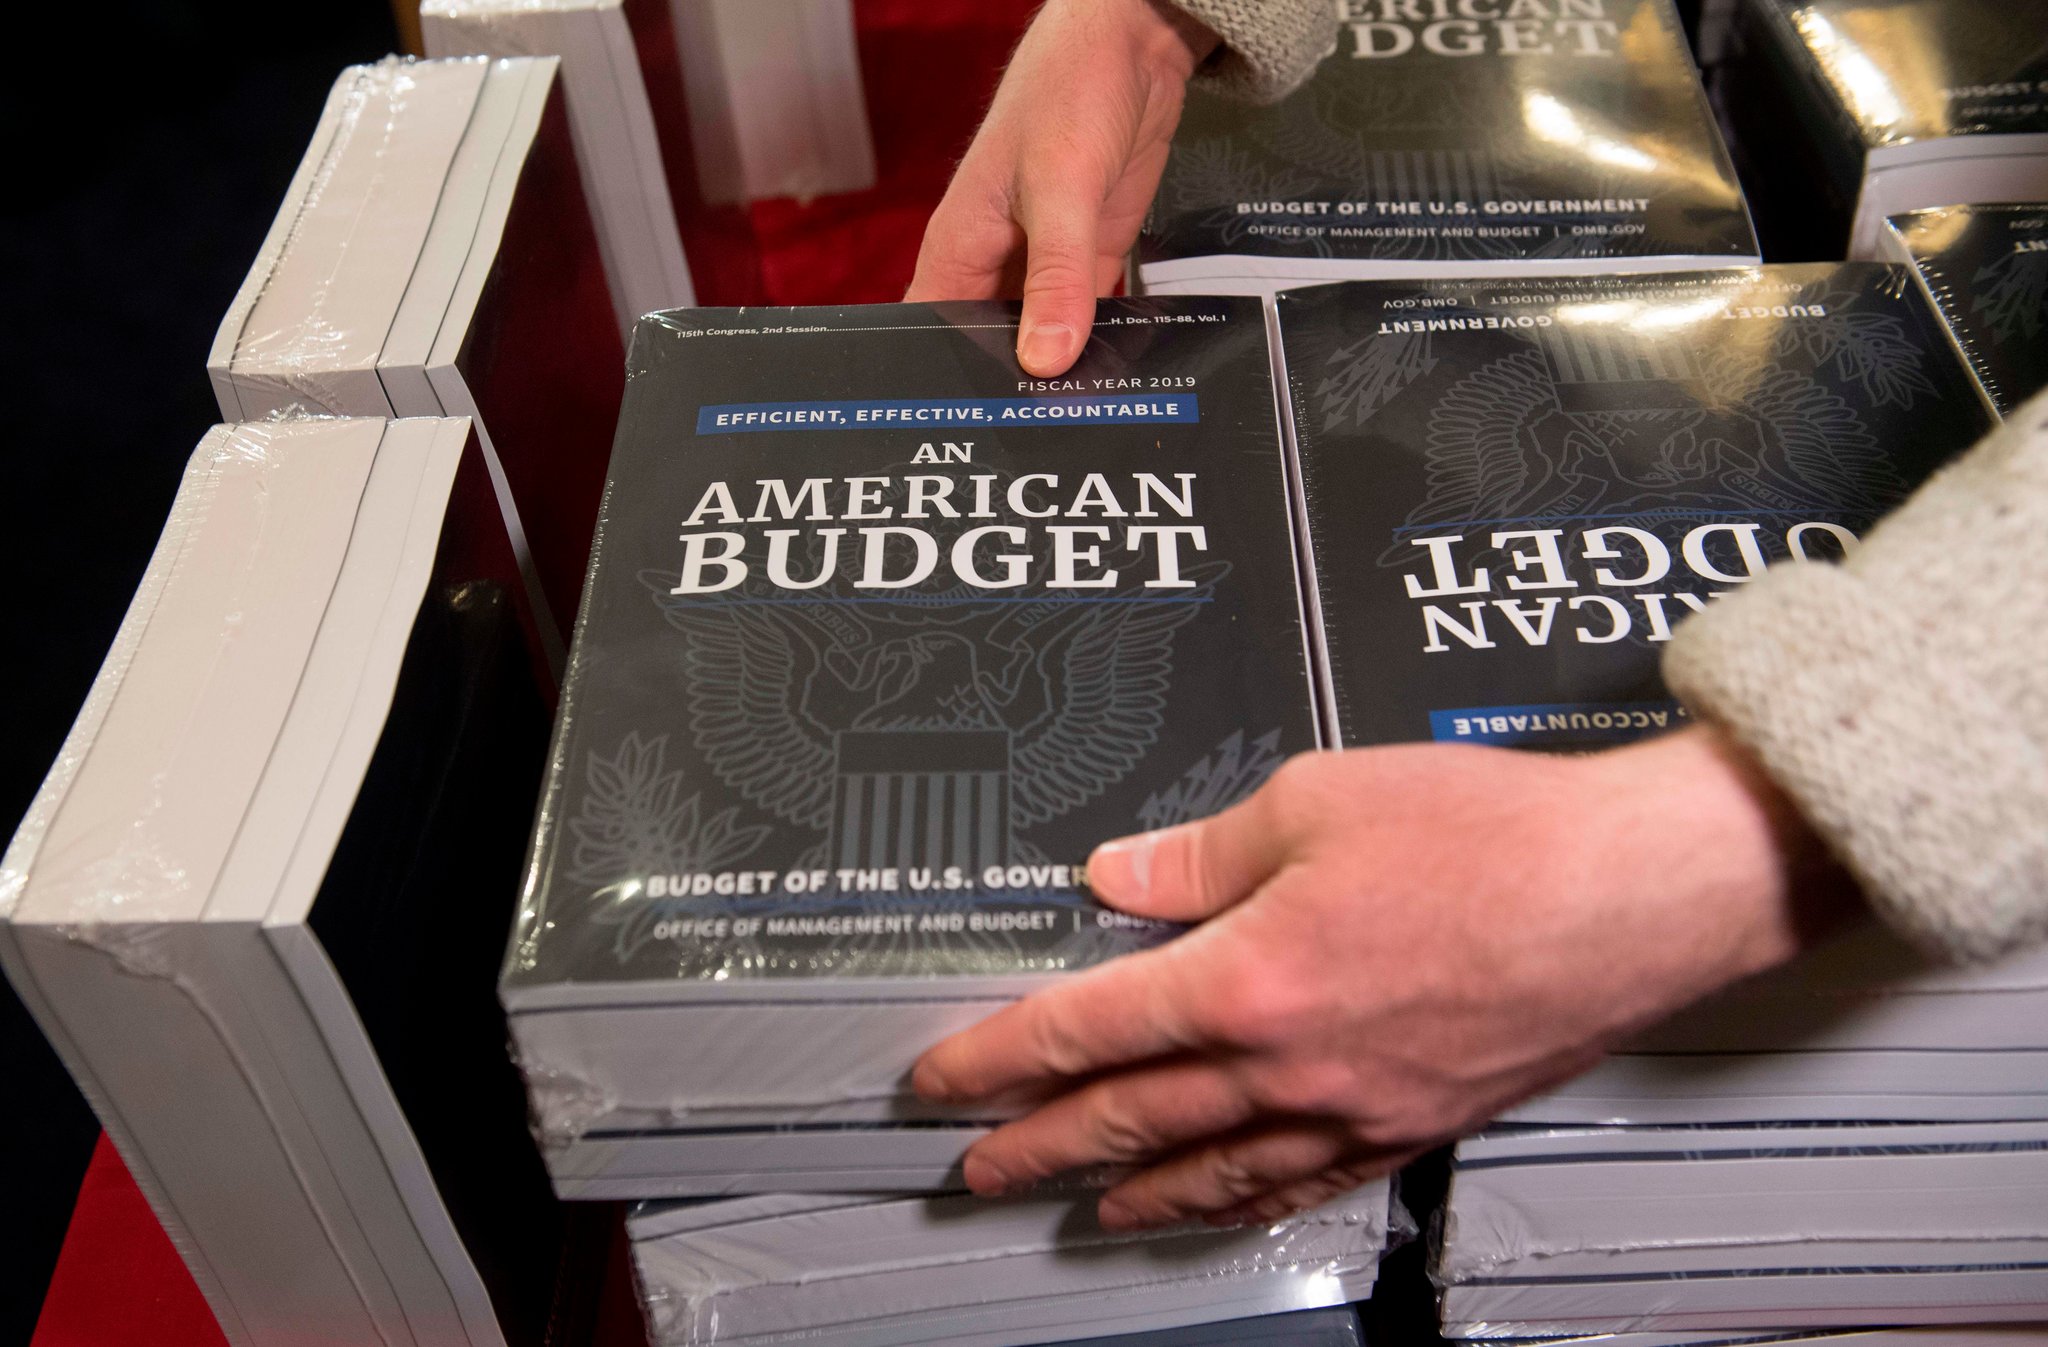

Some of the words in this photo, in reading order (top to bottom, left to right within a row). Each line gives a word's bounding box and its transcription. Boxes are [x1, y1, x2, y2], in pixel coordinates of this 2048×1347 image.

[1236, 202, 1330, 215] BUDGET
[1338, 201, 1370, 215] OF
[1376, 202, 1422, 215] THE
[1429, 201, 1477, 215] U.S.
[1483, 198, 1649, 215] GOVERNMENT
[1247, 225, 1300, 236] OFFICE
[1305, 227, 1325, 236] OF
[1330, 227, 1437, 237] MANAGEMENT
[1442, 227, 1473, 237] AND
[1478, 226, 1541, 237] BUDGET
[1571, 223, 1645, 237] OMB.GOV
[1383, 297, 1458, 309] OMB.GOV
[1490, 294, 1555, 305] BUDGET
[1560, 292, 1594, 303] AND
[1126, 316, 1152, 324] Doc.
[1153, 315, 1196, 324] 115-88,
[1198, 314, 1221, 322] Vol.
[1721, 304, 1826, 320] BUDGET
[676, 330, 704, 339] 115th
[706, 327, 760, 336] Congress,
[762, 326, 783, 334] 2nd
[1378, 315, 1553, 334] GOVERNMENT
[1018, 380, 1085, 391] FISCAL
[1092, 378, 1143, 388] YEAR
[1149, 377, 1196, 387] 2019
[716, 409, 848, 427] EFFICIENT,
[855, 407, 994, 423] EFFECTIVE,
[1001, 403, 1180, 419] ACCOUNTABLE
[910, 442, 975, 464] AN
[682, 472, 1197, 526] AMERICAN
[670, 525, 1208, 595] BUDGET
[1453, 711, 1668, 735] ACCOUNTABLE
[646, 871, 776, 898] BUDGET
[784, 870, 828, 893] OF
[836, 868, 899, 891] THE
[908, 867, 973, 890] U.S.
[653, 919, 728, 940] OFFICE
[732, 918, 762, 937] OF
[766, 914, 914, 936] MANAGEMENT
[918, 912, 964, 932] AND
[969, 911, 1057, 931] BUDGET
